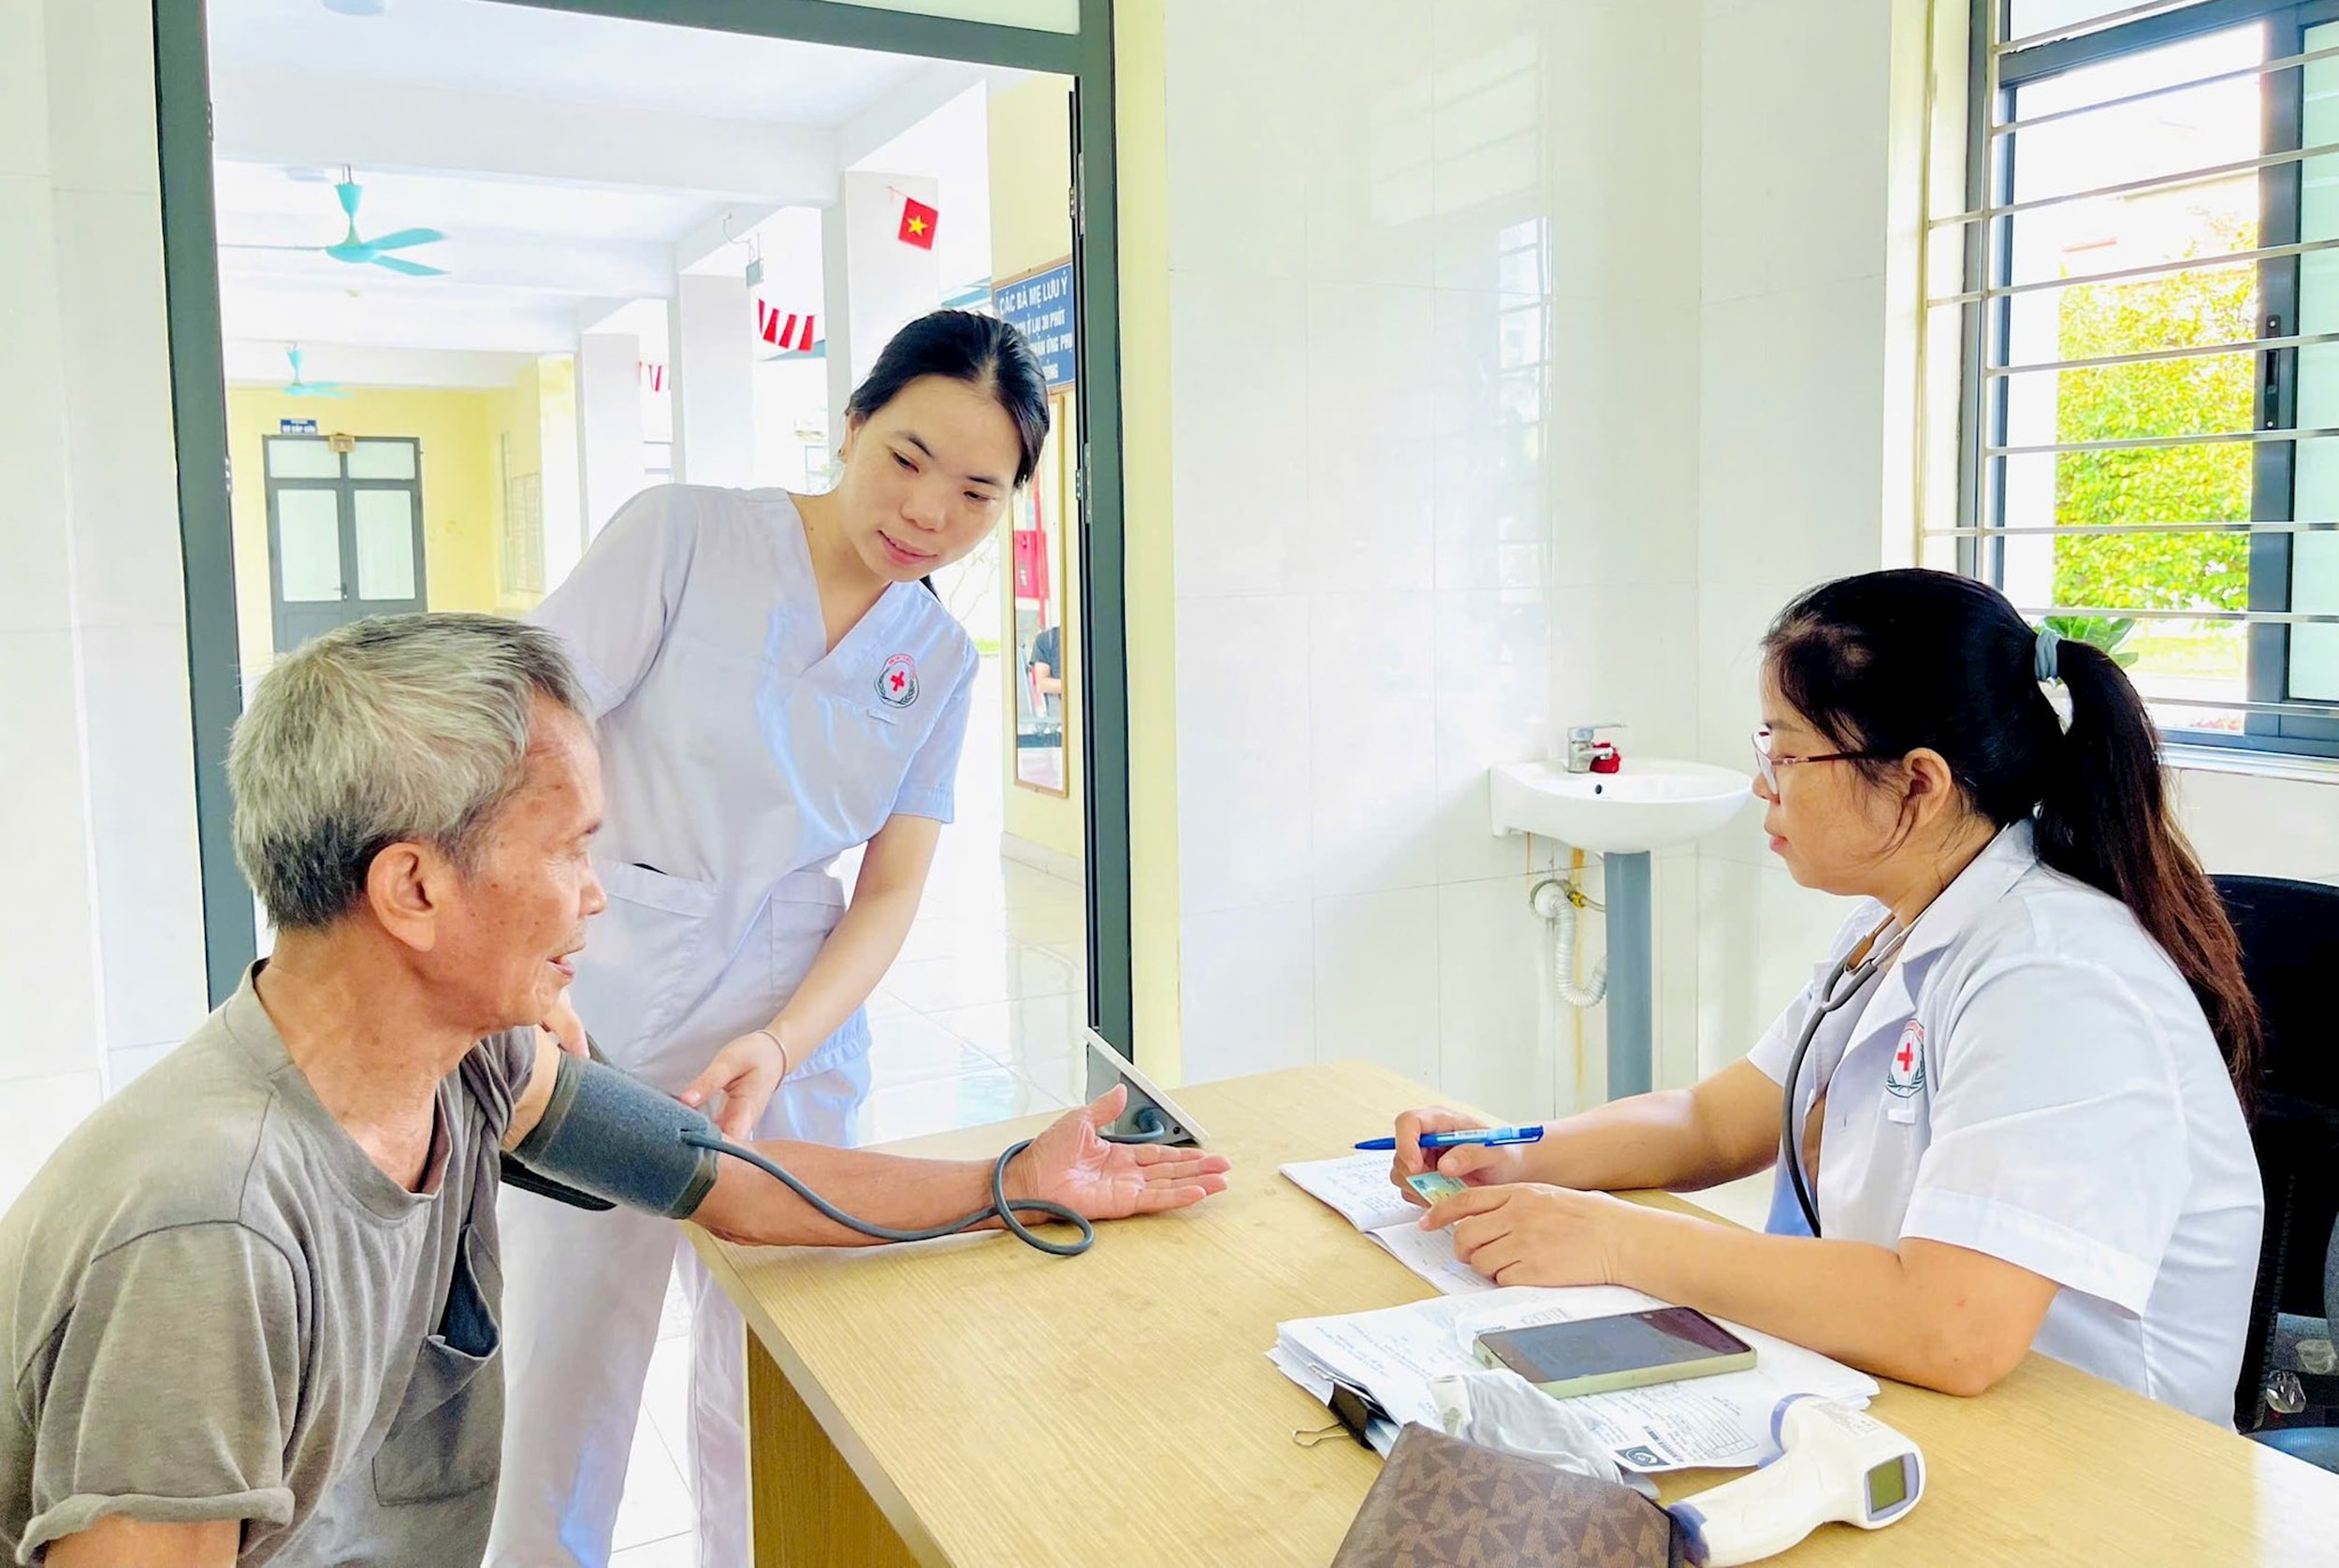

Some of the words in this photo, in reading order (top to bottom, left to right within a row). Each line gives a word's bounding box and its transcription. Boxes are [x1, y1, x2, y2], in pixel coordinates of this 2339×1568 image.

[999, 290, 1016, 315] CÁC
[1017, 286, 1028, 311] BÀ
[1029, 287, 1042, 309] MẸ
[1061, 270, 1068, 296] Ý
